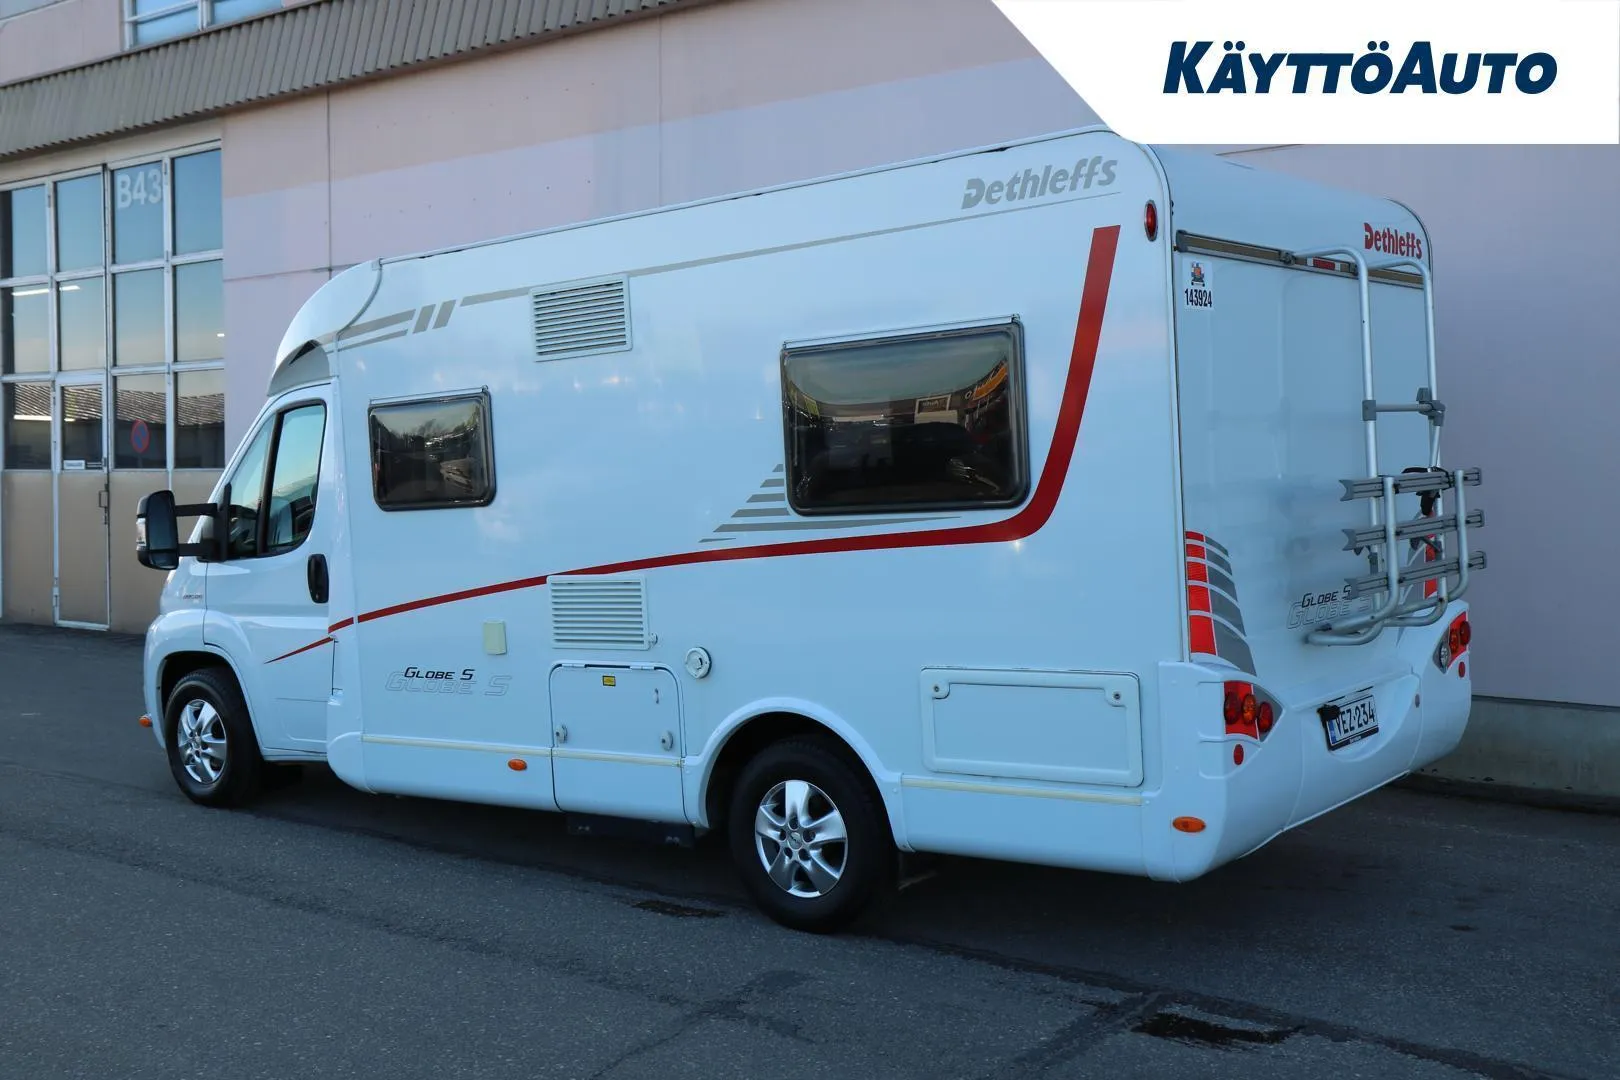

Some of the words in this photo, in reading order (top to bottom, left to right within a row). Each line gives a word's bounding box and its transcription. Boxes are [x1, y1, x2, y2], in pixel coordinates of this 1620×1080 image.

[116, 169, 161, 208] B43
[961, 156, 1118, 209] Dethleffs
[1364, 222, 1422, 259] Dethleffs
[1185, 288, 1212, 307] 143924
[460, 669, 475, 680] S
[485, 675, 512, 696] S
